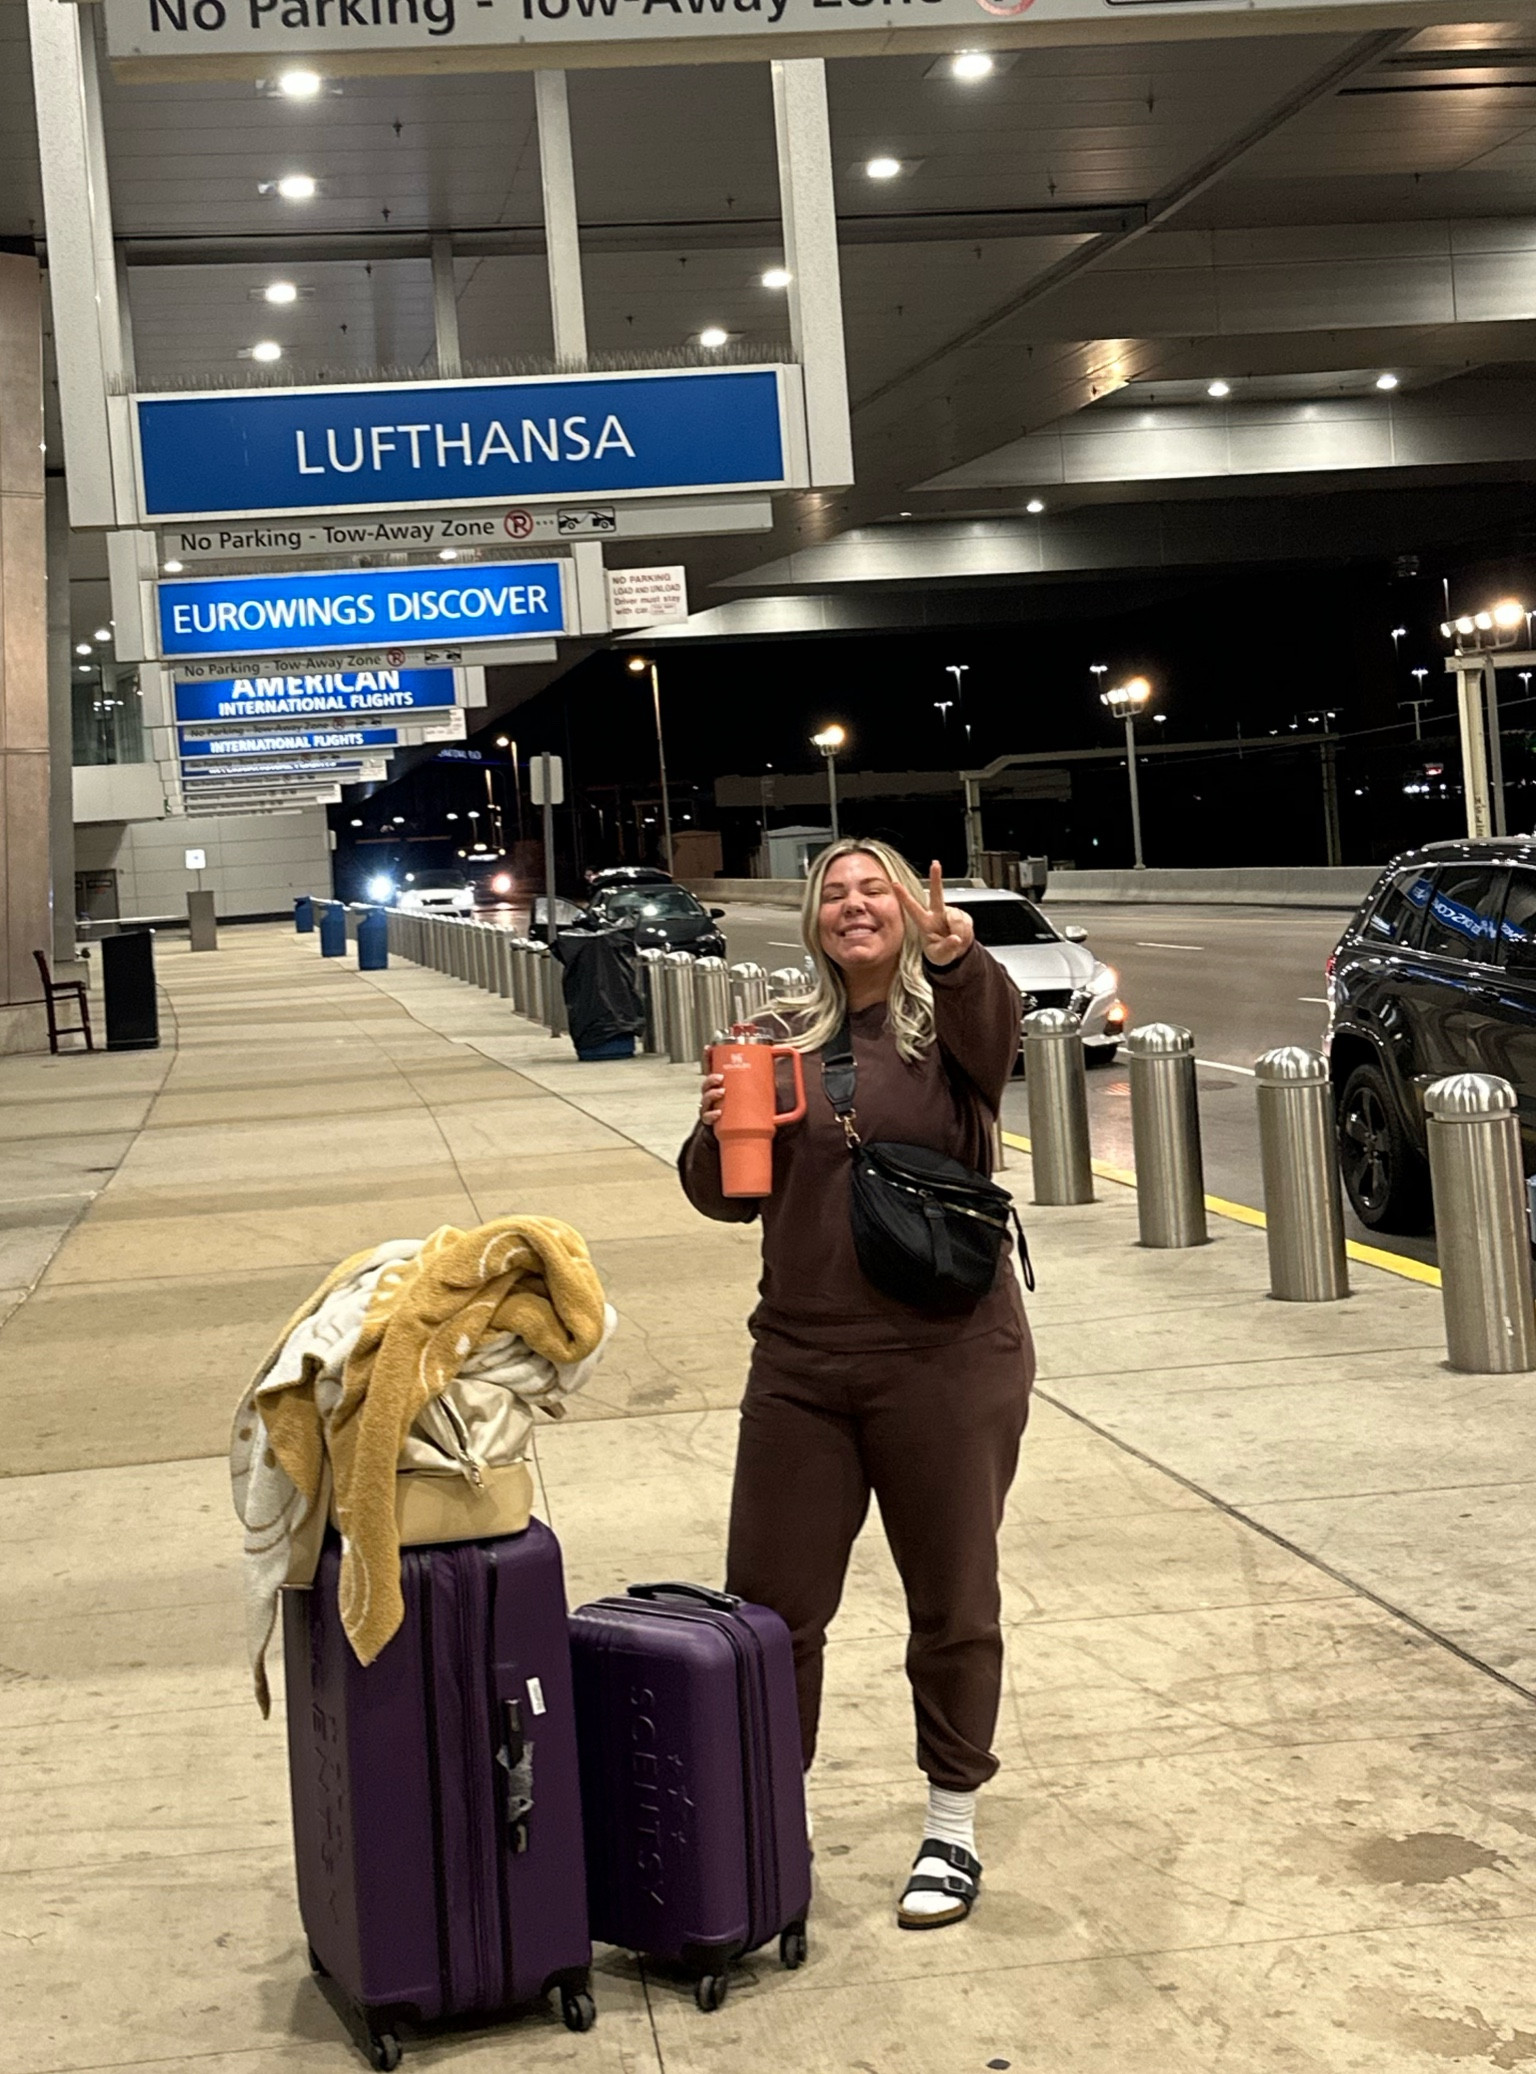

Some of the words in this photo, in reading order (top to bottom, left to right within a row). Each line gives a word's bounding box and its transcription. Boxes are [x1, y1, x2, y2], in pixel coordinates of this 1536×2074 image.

[150, 0, 226, 32] No
[251, 0, 455, 36] Parking
[296, 414, 637, 475] LUFTHANSA
[180, 533, 212, 551] No
[219, 528, 301, 551] Parking
[323, 523, 434, 543] Tow-Away
[441, 519, 495, 538] Zone
[612, 575, 627, 585] NO
[629, 573, 671, 583] PARKING
[613, 586, 633, 596] LOAD
[173, 594, 375, 634] EUROWINGS
[388, 585, 549, 622] DISCOVER
[184, 665, 205, 677] No
[208, 661, 261, 675] Parking
[272, 656, 344, 671] Tow-Away
[347, 654, 382, 667] Zone
[231, 670, 400, 699] AMERICAN
[218, 695, 347, 716] INTERNATIONAL
[350, 692, 414, 709] FLIGHTS
[210, 735, 311, 754] INTERNATIONAL
[313, 733, 363, 747] FLIGHTS
